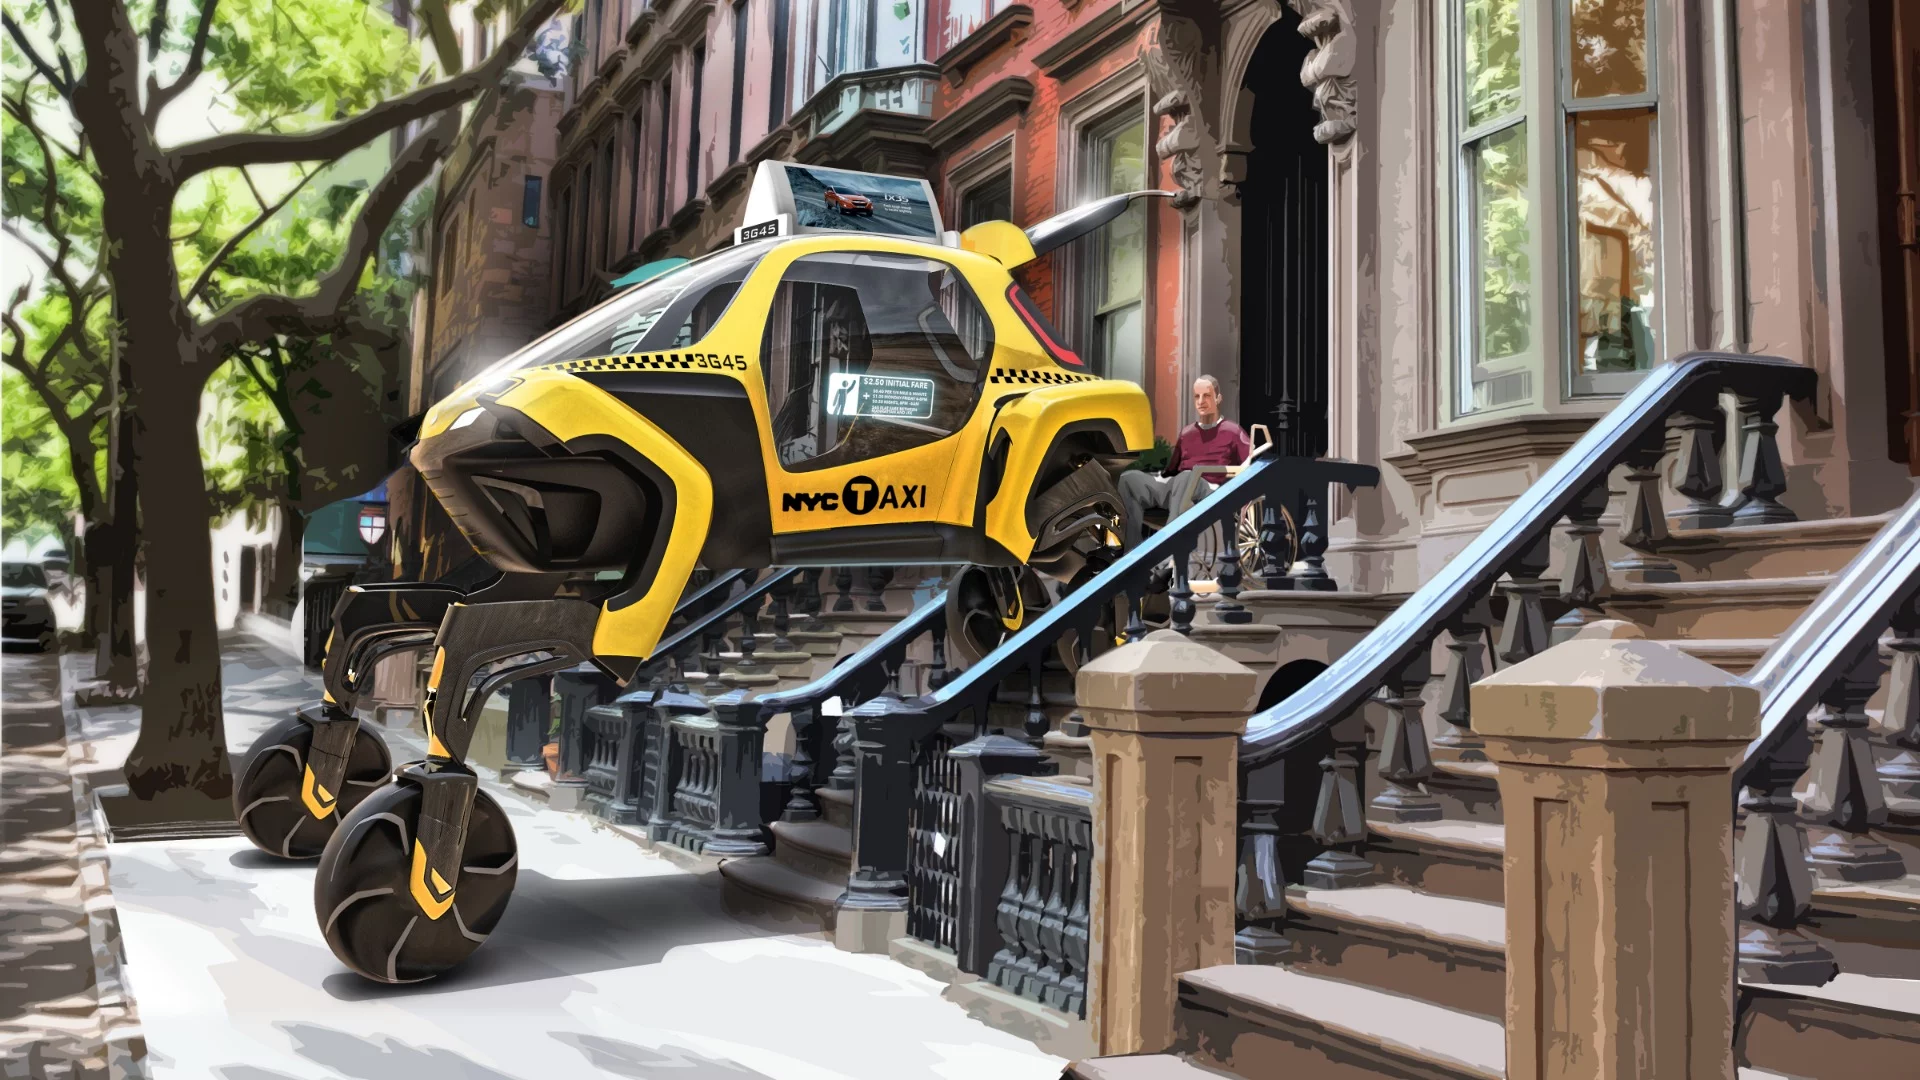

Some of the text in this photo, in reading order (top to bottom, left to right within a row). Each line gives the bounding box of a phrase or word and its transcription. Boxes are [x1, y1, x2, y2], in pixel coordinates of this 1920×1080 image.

[743, 223, 776, 240] 3G45
[694, 353, 748, 371] 3G45
[863, 377, 928, 389] $2.50 INITIAL FARE
[782, 492, 839, 511] NYC
